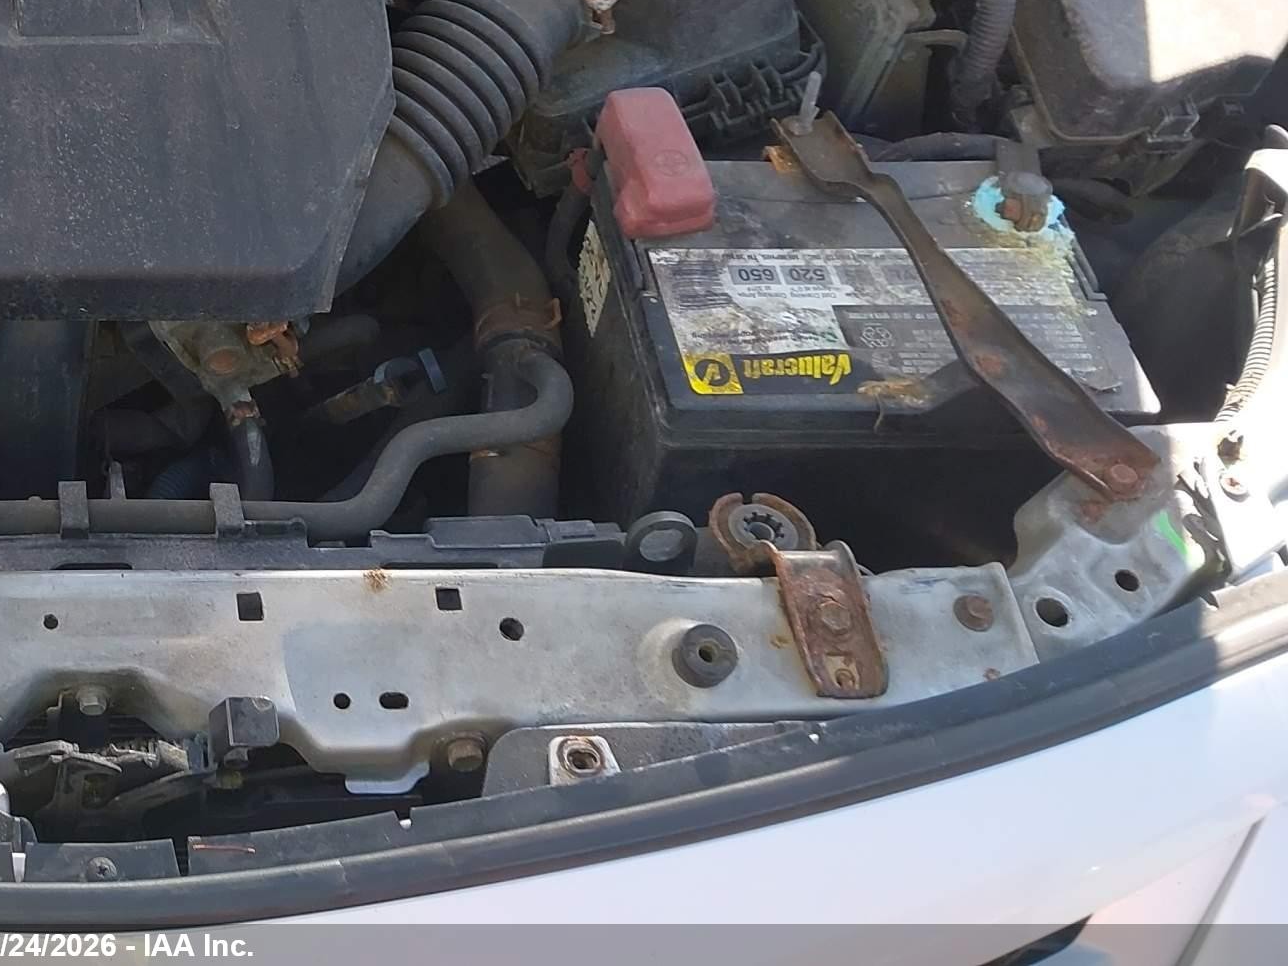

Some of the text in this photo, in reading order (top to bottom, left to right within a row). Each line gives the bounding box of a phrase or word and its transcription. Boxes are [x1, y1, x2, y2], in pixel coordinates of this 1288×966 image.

[738, 267, 774, 281] 650
[789, 268, 825, 281] 520
[743, 353, 852, 386] Valucraft
